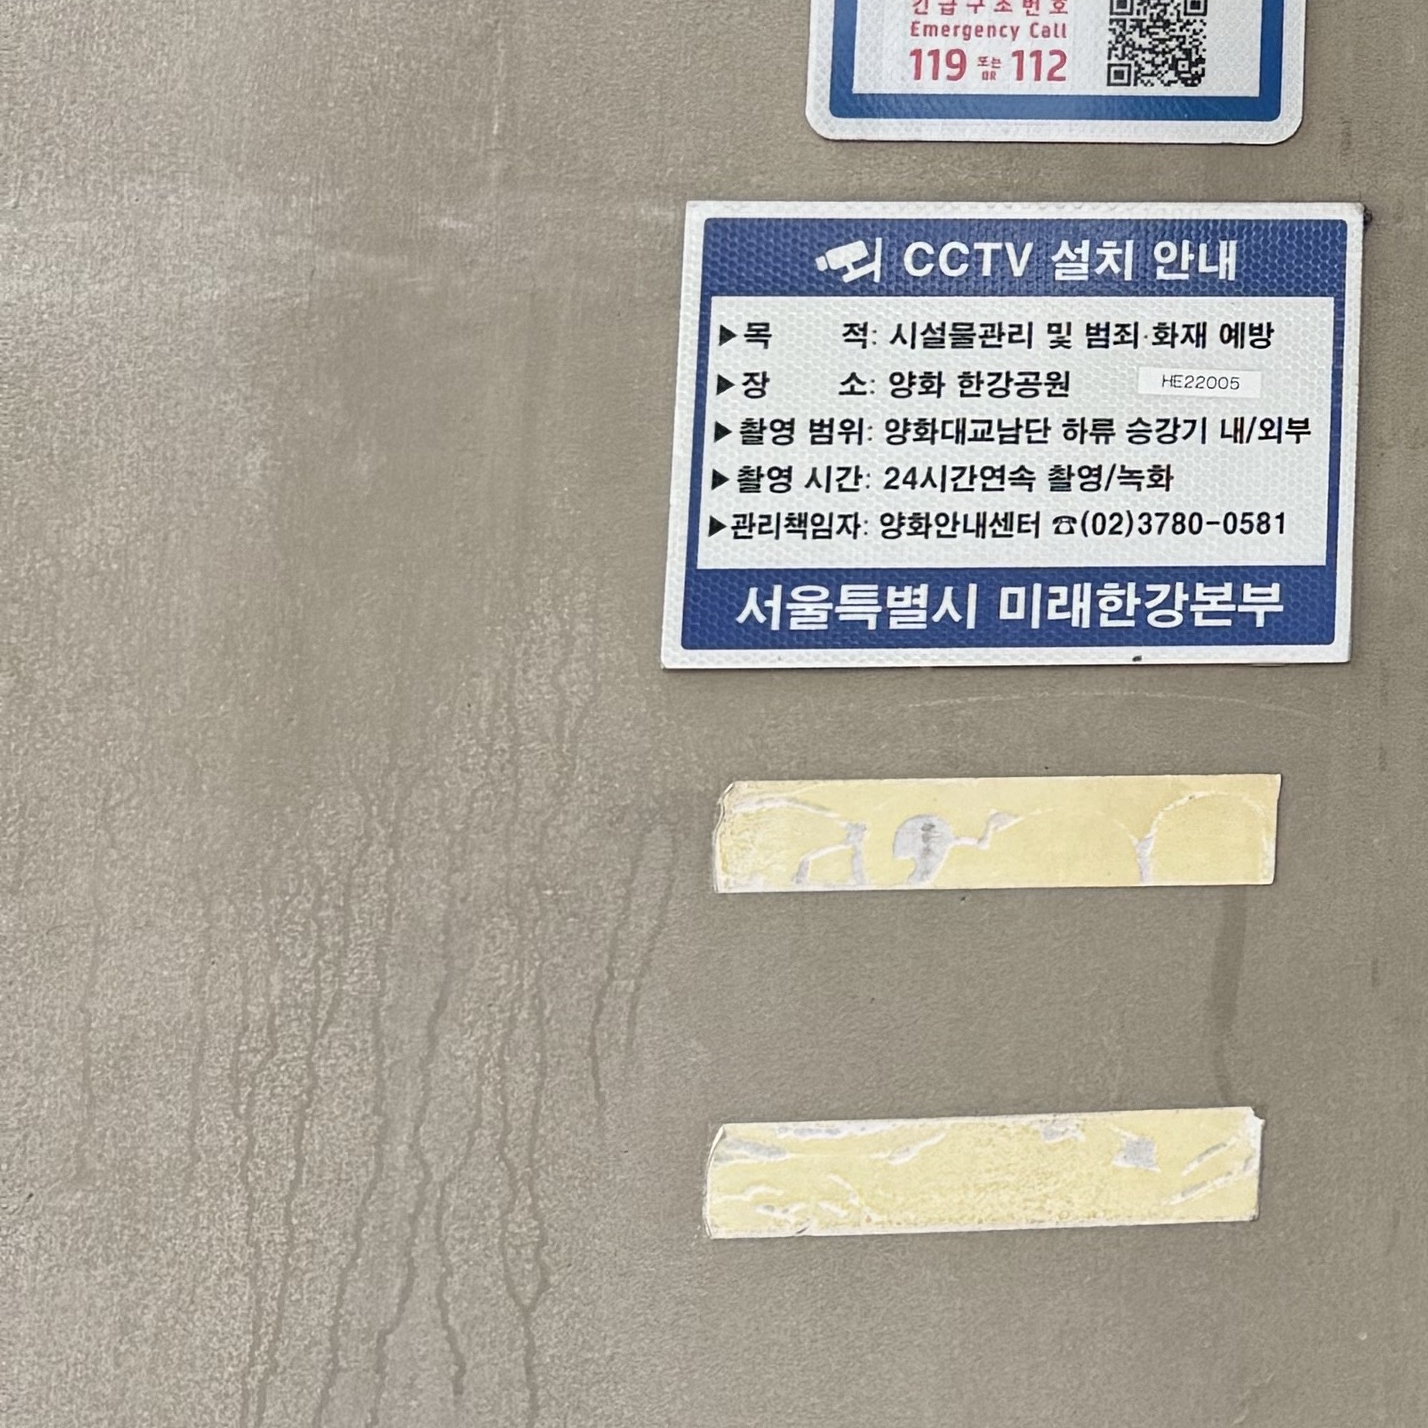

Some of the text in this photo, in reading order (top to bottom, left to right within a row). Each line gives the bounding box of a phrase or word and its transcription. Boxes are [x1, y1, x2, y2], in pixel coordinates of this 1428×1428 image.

[910, 21, 1067, 41] Emergency Call
[909, 48, 1068, 82] 119 또는 112
[981, 70, 997, 81] OR
[903, 239, 1238, 281] CCTV 설치 안내
[743, 321, 773, 349] 목
[889, 321, 1034, 350] 시설물관리
[1047, 321, 1073, 350] 및
[1219, 321, 1275, 350] 예방
[742, 371, 771, 399] 장
[889, 370, 946, 399] 양화
[957, 370, 1071, 399] 한강공원
[1161, 374, 1241, 391] HE22005
[739, 416, 1312, 446] 촬영 범위: 양화대교남단 하류 승강기 내/외부
[736, 462, 1174, 494] 촬영 시간: 24시간연속 촬영/녹화
[730, 509, 1286, 541] 관리책임자: 양화안내센터 (02)3780-0581
[735, 581, 1285, 632] 서울특별시 미래한강본부
